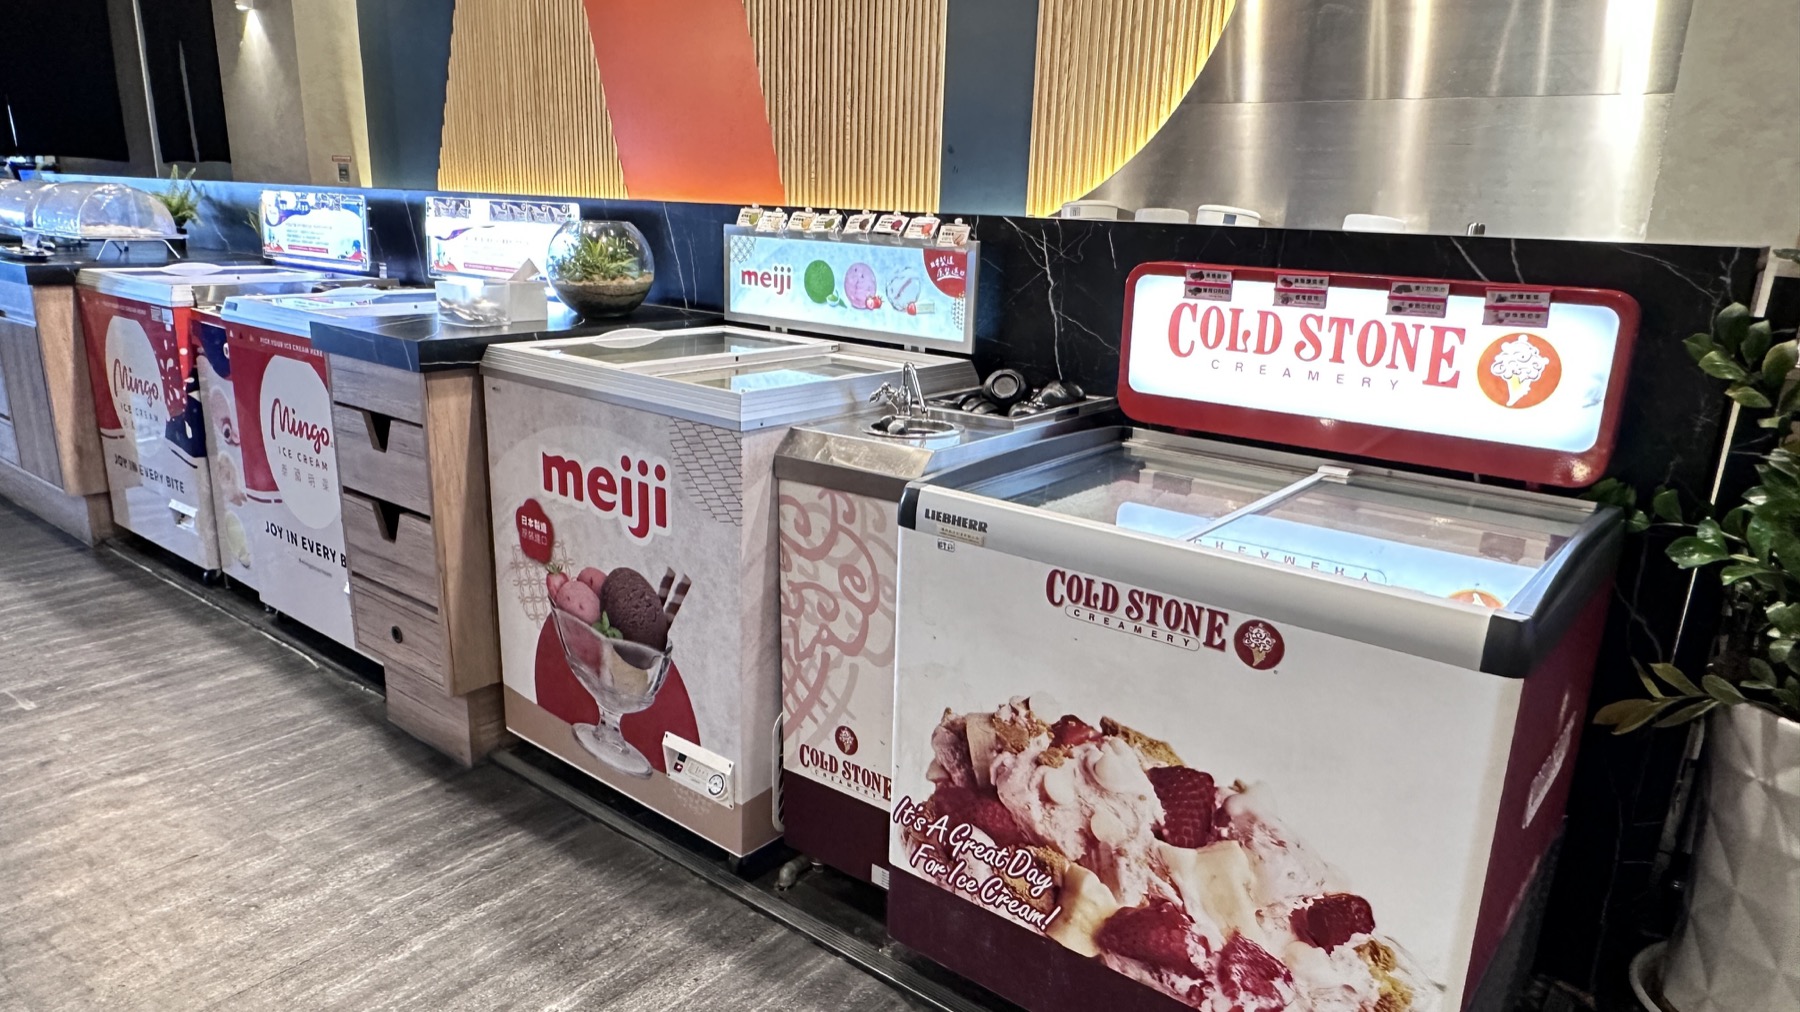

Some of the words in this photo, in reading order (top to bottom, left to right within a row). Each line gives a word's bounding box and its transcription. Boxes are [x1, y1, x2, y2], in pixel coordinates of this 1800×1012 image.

[741, 265, 792, 295] meiji
[1168, 302, 1283, 358] COLD
[1294, 313, 1466, 389] STONE
[113, 358, 159, 408] Mingo
[1211, 359, 1399, 391] CREAMERY
[270, 398, 330, 454] Mingo
[114, 453, 128, 469] JOY
[139, 464, 164, 484] EVERY
[165, 475, 185, 495] BITE
[278, 446, 293, 459] ICE
[297, 452, 328, 472] CREAM
[541, 451, 668, 540] meiji
[265, 520, 284, 540] JOY
[286, 529, 298, 547] IN
[301, 536, 336, 563] EVERY
[924, 508, 988, 534] LIEBHERR
[1046, 568, 1120, 614] COLD
[1125, 588, 1230, 652] STONE
[1073, 607, 1191, 648] CREAMERY
[799, 744, 839, 774] COLD
[842, 760, 892, 803] STONE
[893, 796, 927, 833] It's
[927, 814, 949, 844] A
[949, 823, 1008, 869] Great
[1008, 849, 1053, 897] Day
[909, 843, 947, 877] For
[948, 861, 979, 894] Ice
[980, 876, 1063, 932] Cream!
